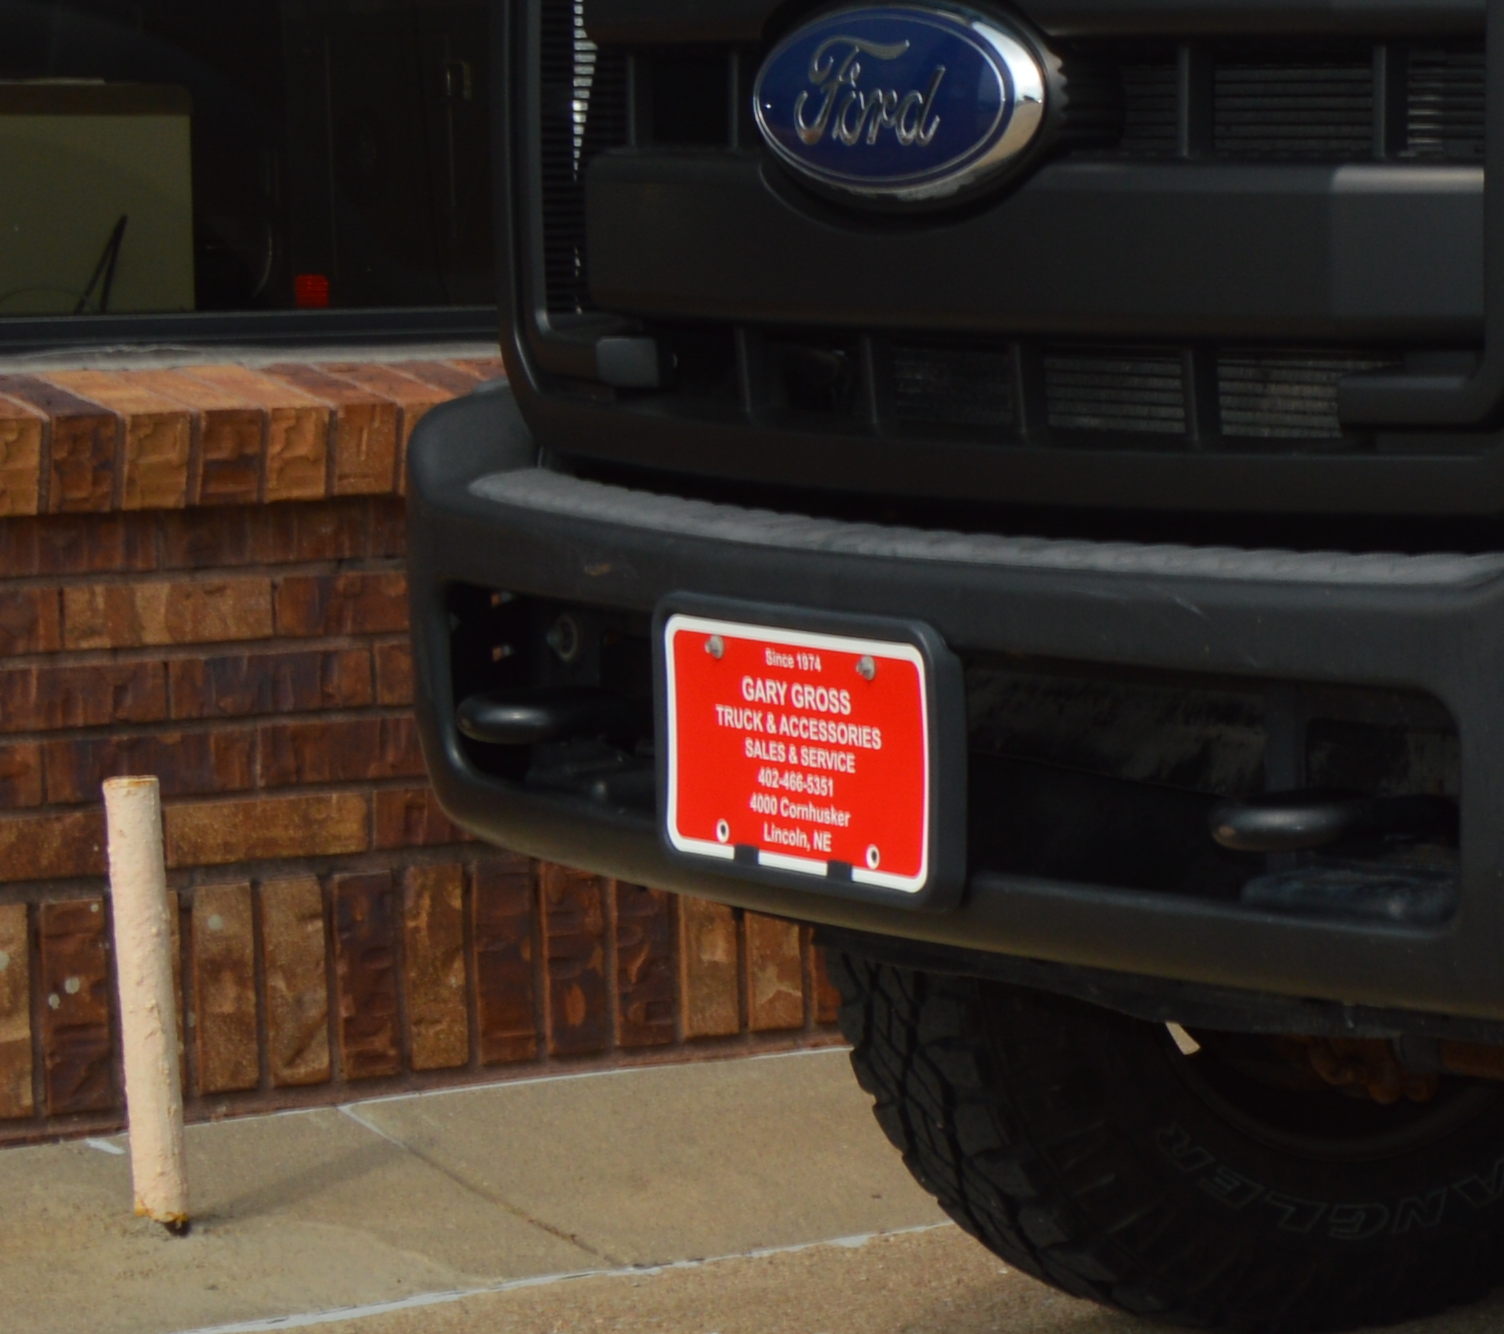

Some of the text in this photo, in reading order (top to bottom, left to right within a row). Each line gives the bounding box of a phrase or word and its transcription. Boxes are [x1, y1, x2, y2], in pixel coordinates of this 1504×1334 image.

[793, 34, 947, 147] Ford
[765, 648, 822, 672] Since 1974
[741, 676, 851, 715] GARY GROSS
[716, 705, 882, 750] TRUCK & ACCESSORIES
[745, 738, 856, 774] SALES & SERVICE
[758, 768, 835, 797] 402-466-5351
[750, 793, 851, 827] 4000 Cornhusker
[764, 824, 832, 852] Lincoln, NE
